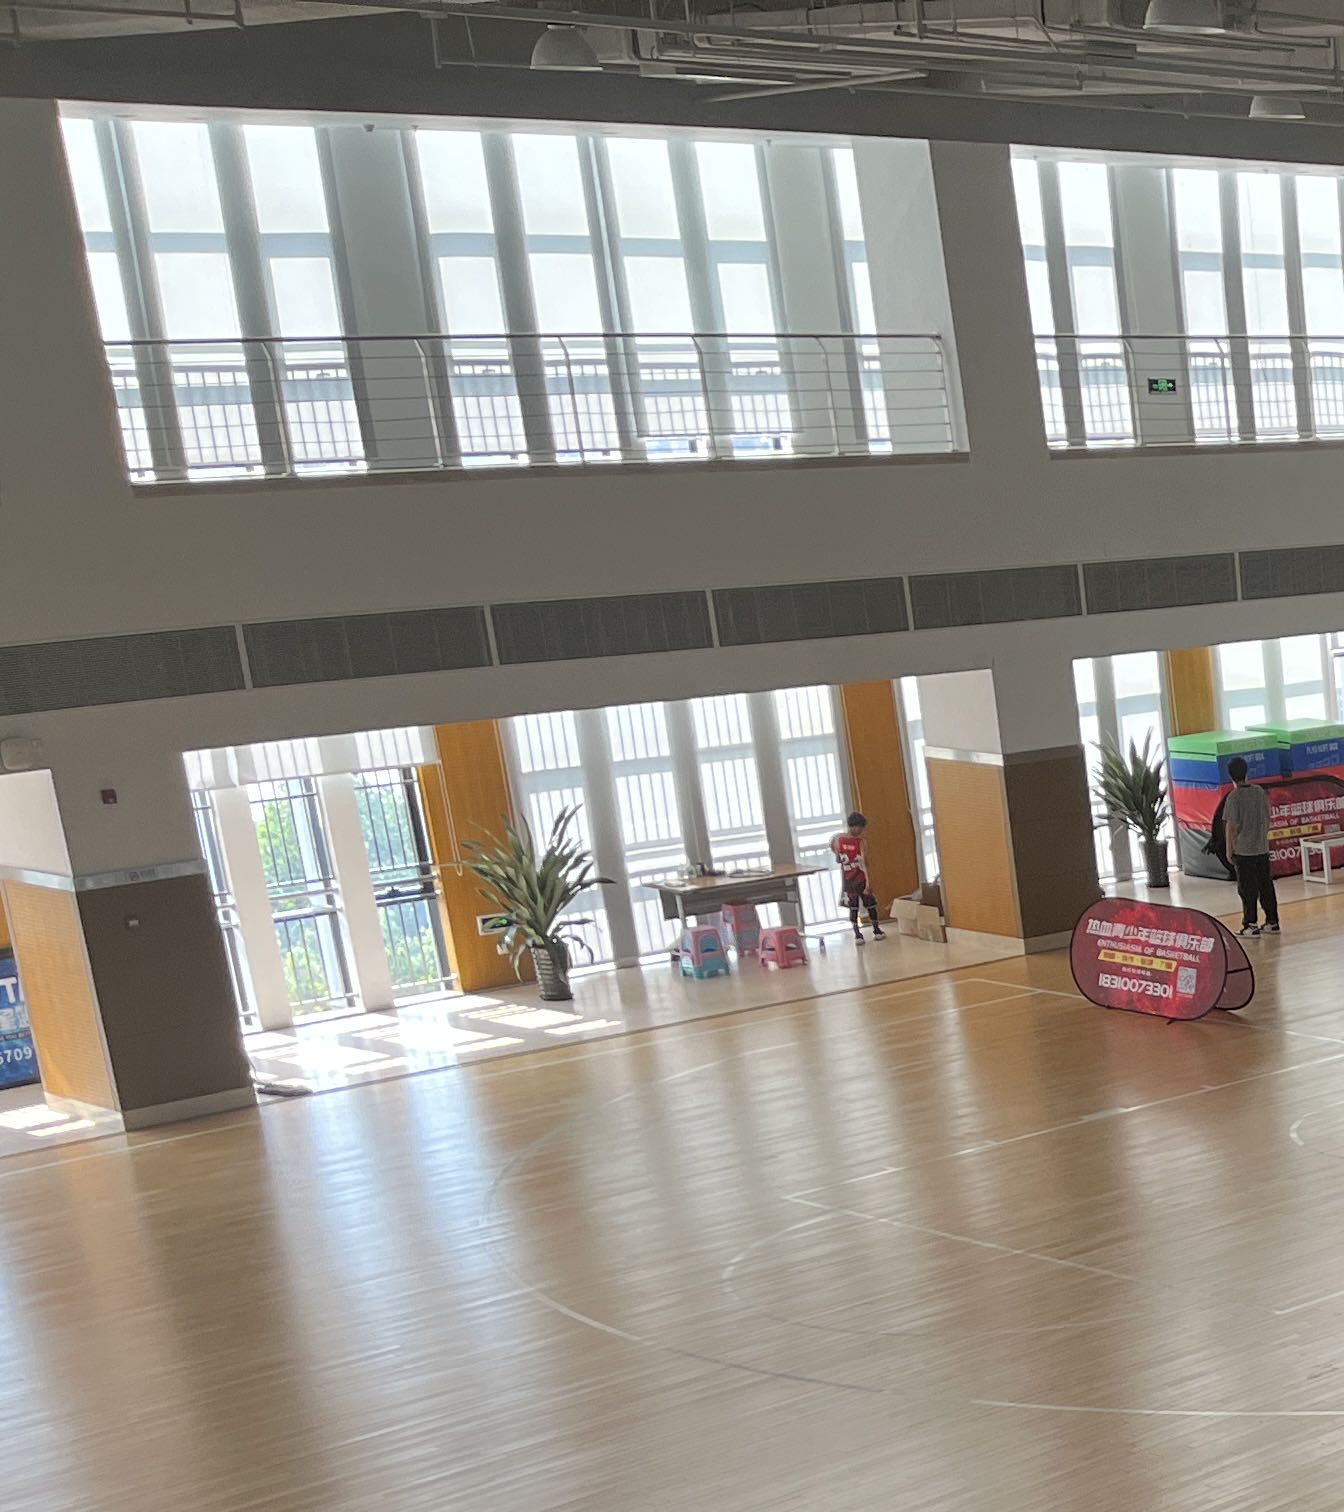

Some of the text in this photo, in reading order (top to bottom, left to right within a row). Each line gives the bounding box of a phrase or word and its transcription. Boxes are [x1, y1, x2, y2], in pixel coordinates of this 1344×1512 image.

[1086, 918, 1215, 953] 热血青少年篮球俱乐部
[1144, 946, 1154, 955] OF
[1156, 948, 1200, 963] BASKETBALL
[1098, 972, 1173, 998] 18310073301
